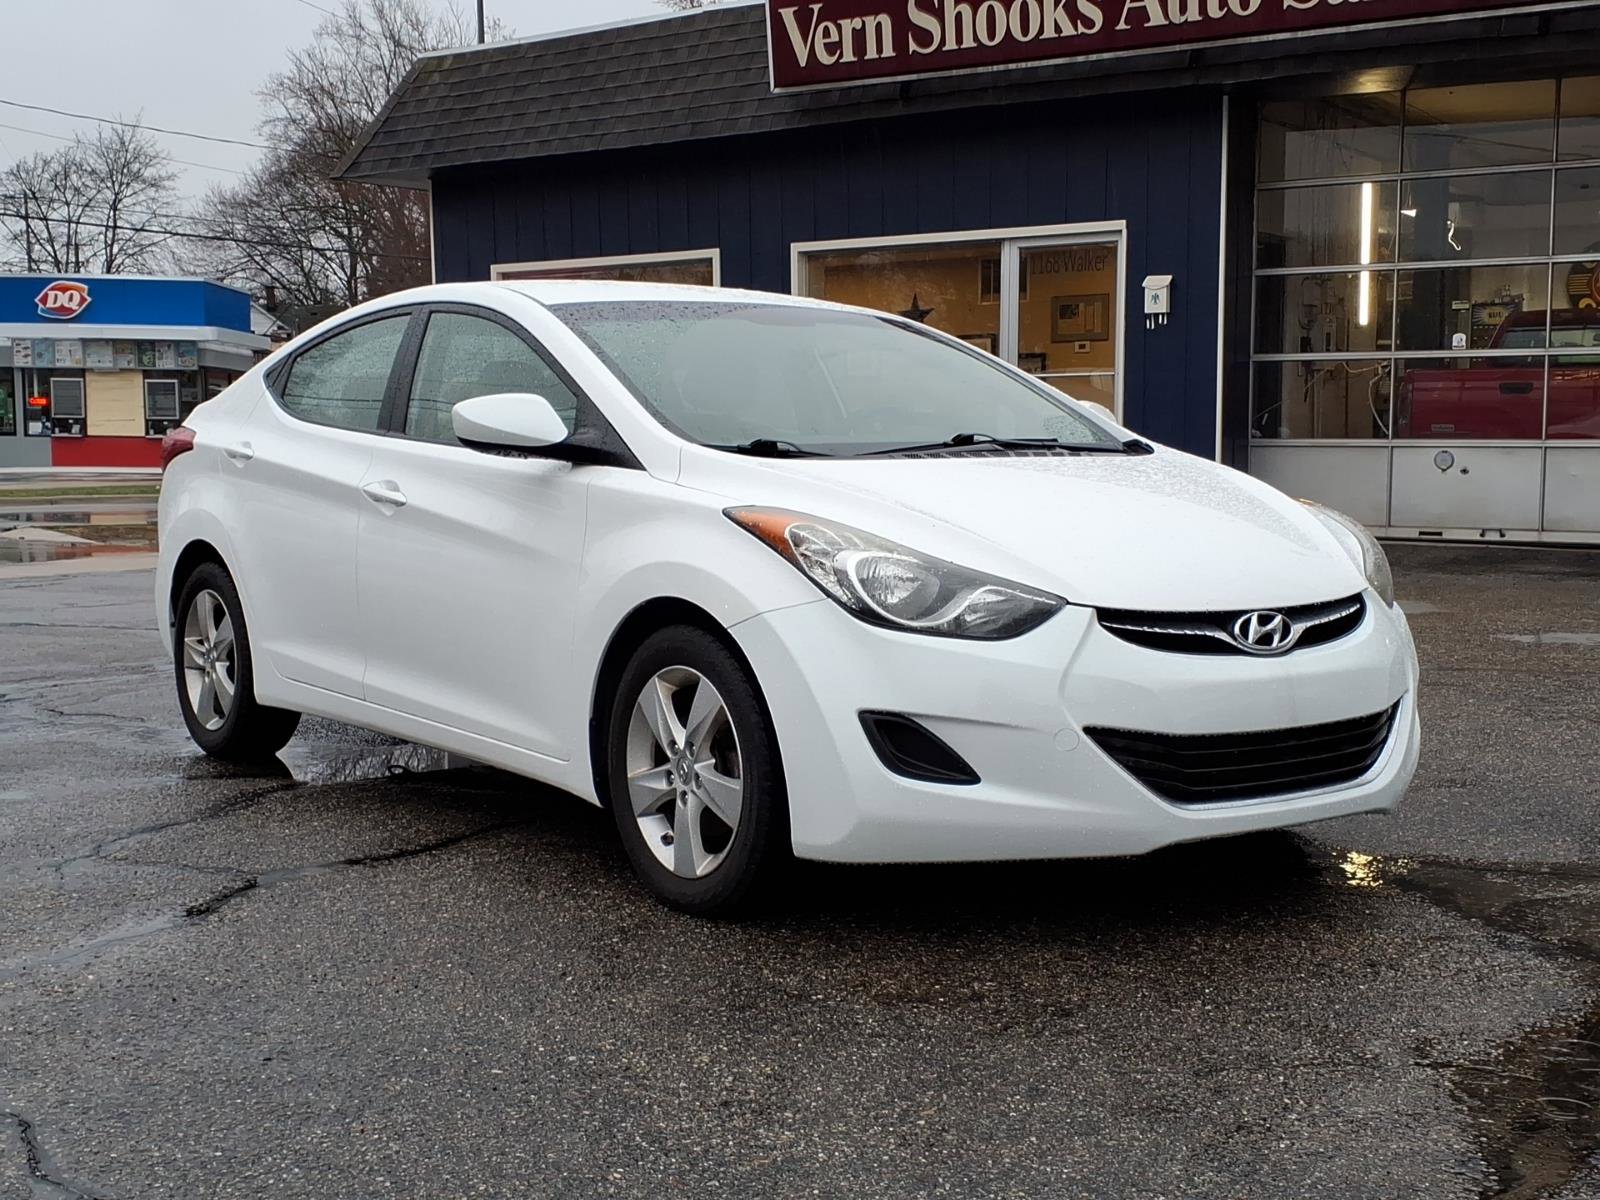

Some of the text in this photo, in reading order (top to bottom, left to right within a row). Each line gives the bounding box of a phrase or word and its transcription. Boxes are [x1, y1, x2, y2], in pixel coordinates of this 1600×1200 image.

[777, 3, 897, 68] Vern
[907, 0, 1104, 56] Shooks
[1063, 247, 1108, 272] Walker
[45, 289, 81, 310] DQ
